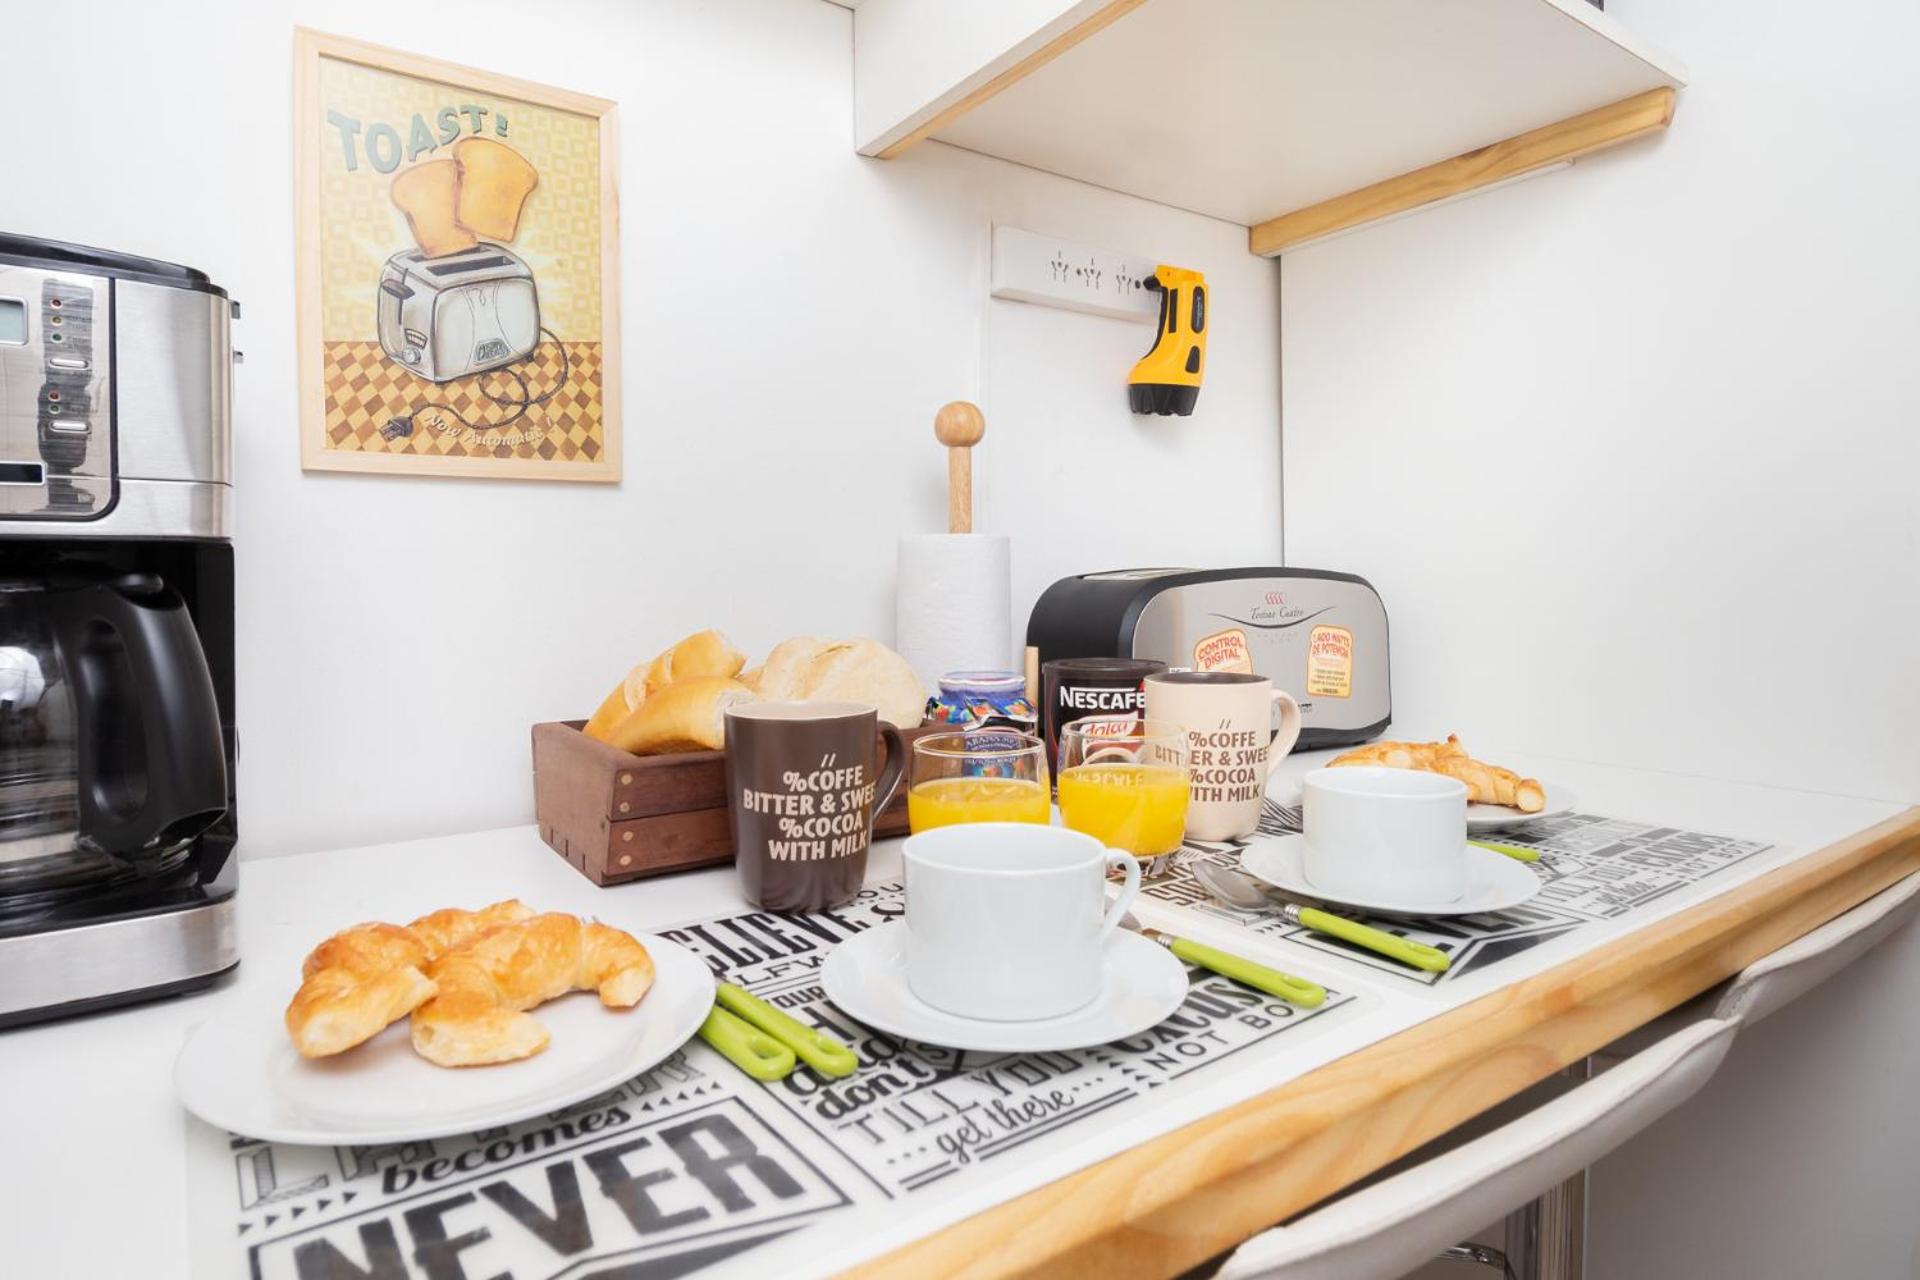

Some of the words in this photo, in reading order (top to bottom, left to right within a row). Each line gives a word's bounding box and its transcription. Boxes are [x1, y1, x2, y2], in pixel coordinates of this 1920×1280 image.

[1199, 636, 1244, 660] CONTROL
[1204, 649, 1241, 669] DIGITAL
[1219, 750, 1232, 766] &
[782, 765, 864, 793] %COFFE
[743, 788, 815, 816] BITTER
[819, 792, 836, 814] &
[1189, 786, 1223, 802] ITH
[1227, 784, 1260, 803] MILK
[778, 810, 864, 839] %COCOA
[768, 839, 826, 862] WITH
[830, 830, 868, 859] MILK
[1142, 1030, 1229, 1072] NOT
[837, 1088, 980, 1145] TILL
[381, 1103, 632, 1196] becomes
[292, 1111, 808, 1280] NEVER
